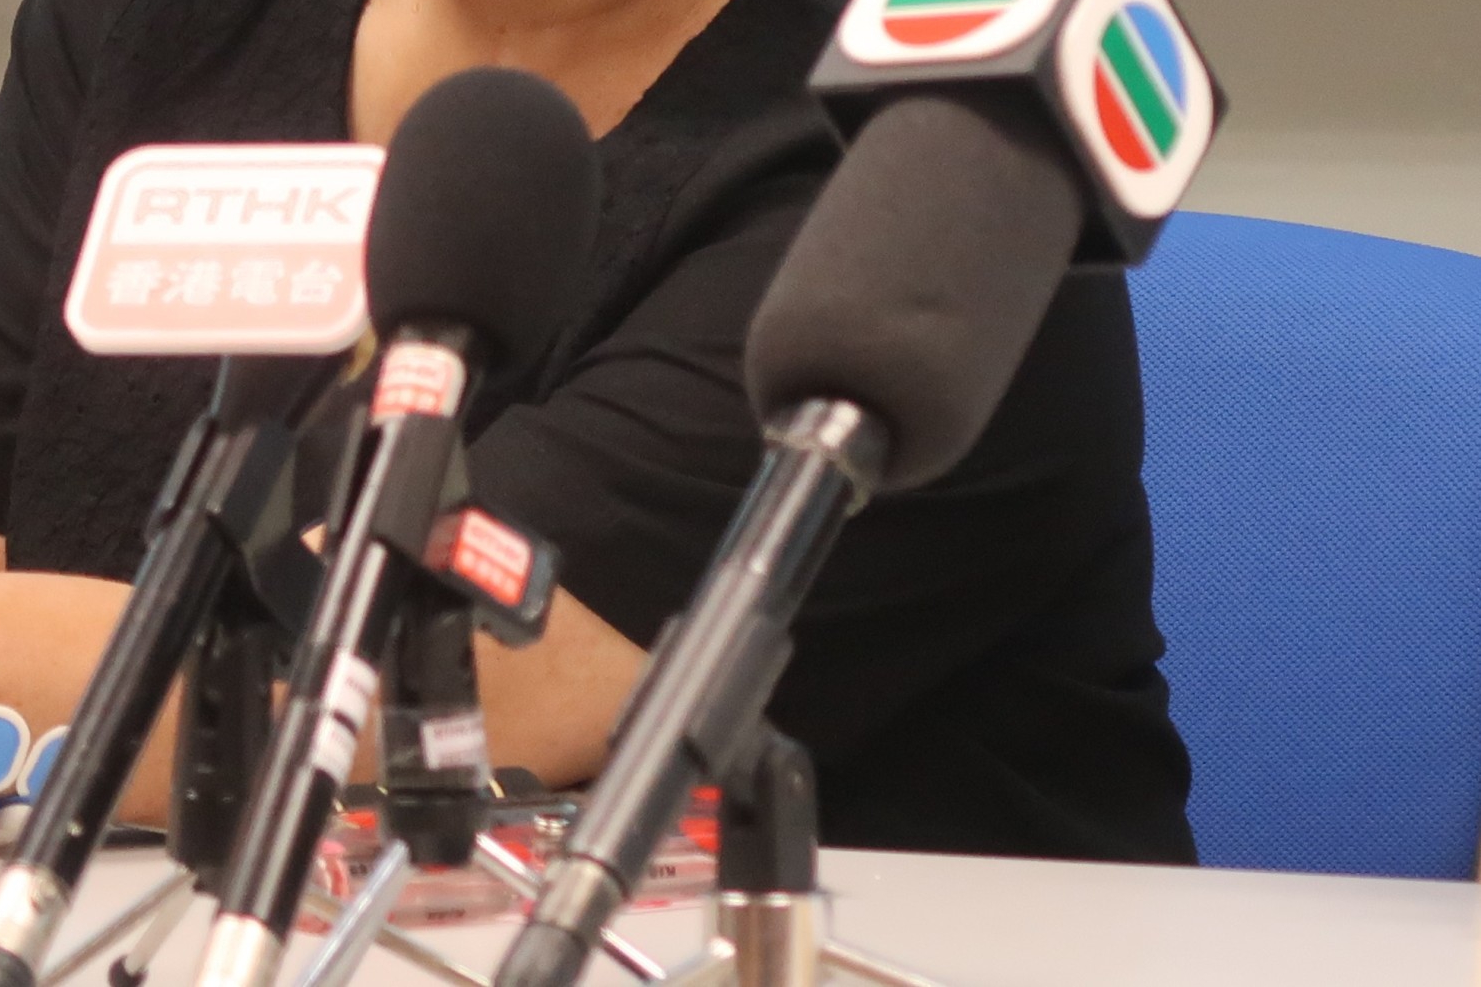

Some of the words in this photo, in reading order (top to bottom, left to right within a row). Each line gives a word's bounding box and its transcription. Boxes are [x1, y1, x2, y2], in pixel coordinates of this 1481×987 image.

[132, 186, 361, 226] RTHK
[105, 259, 345, 306] 香港電台
